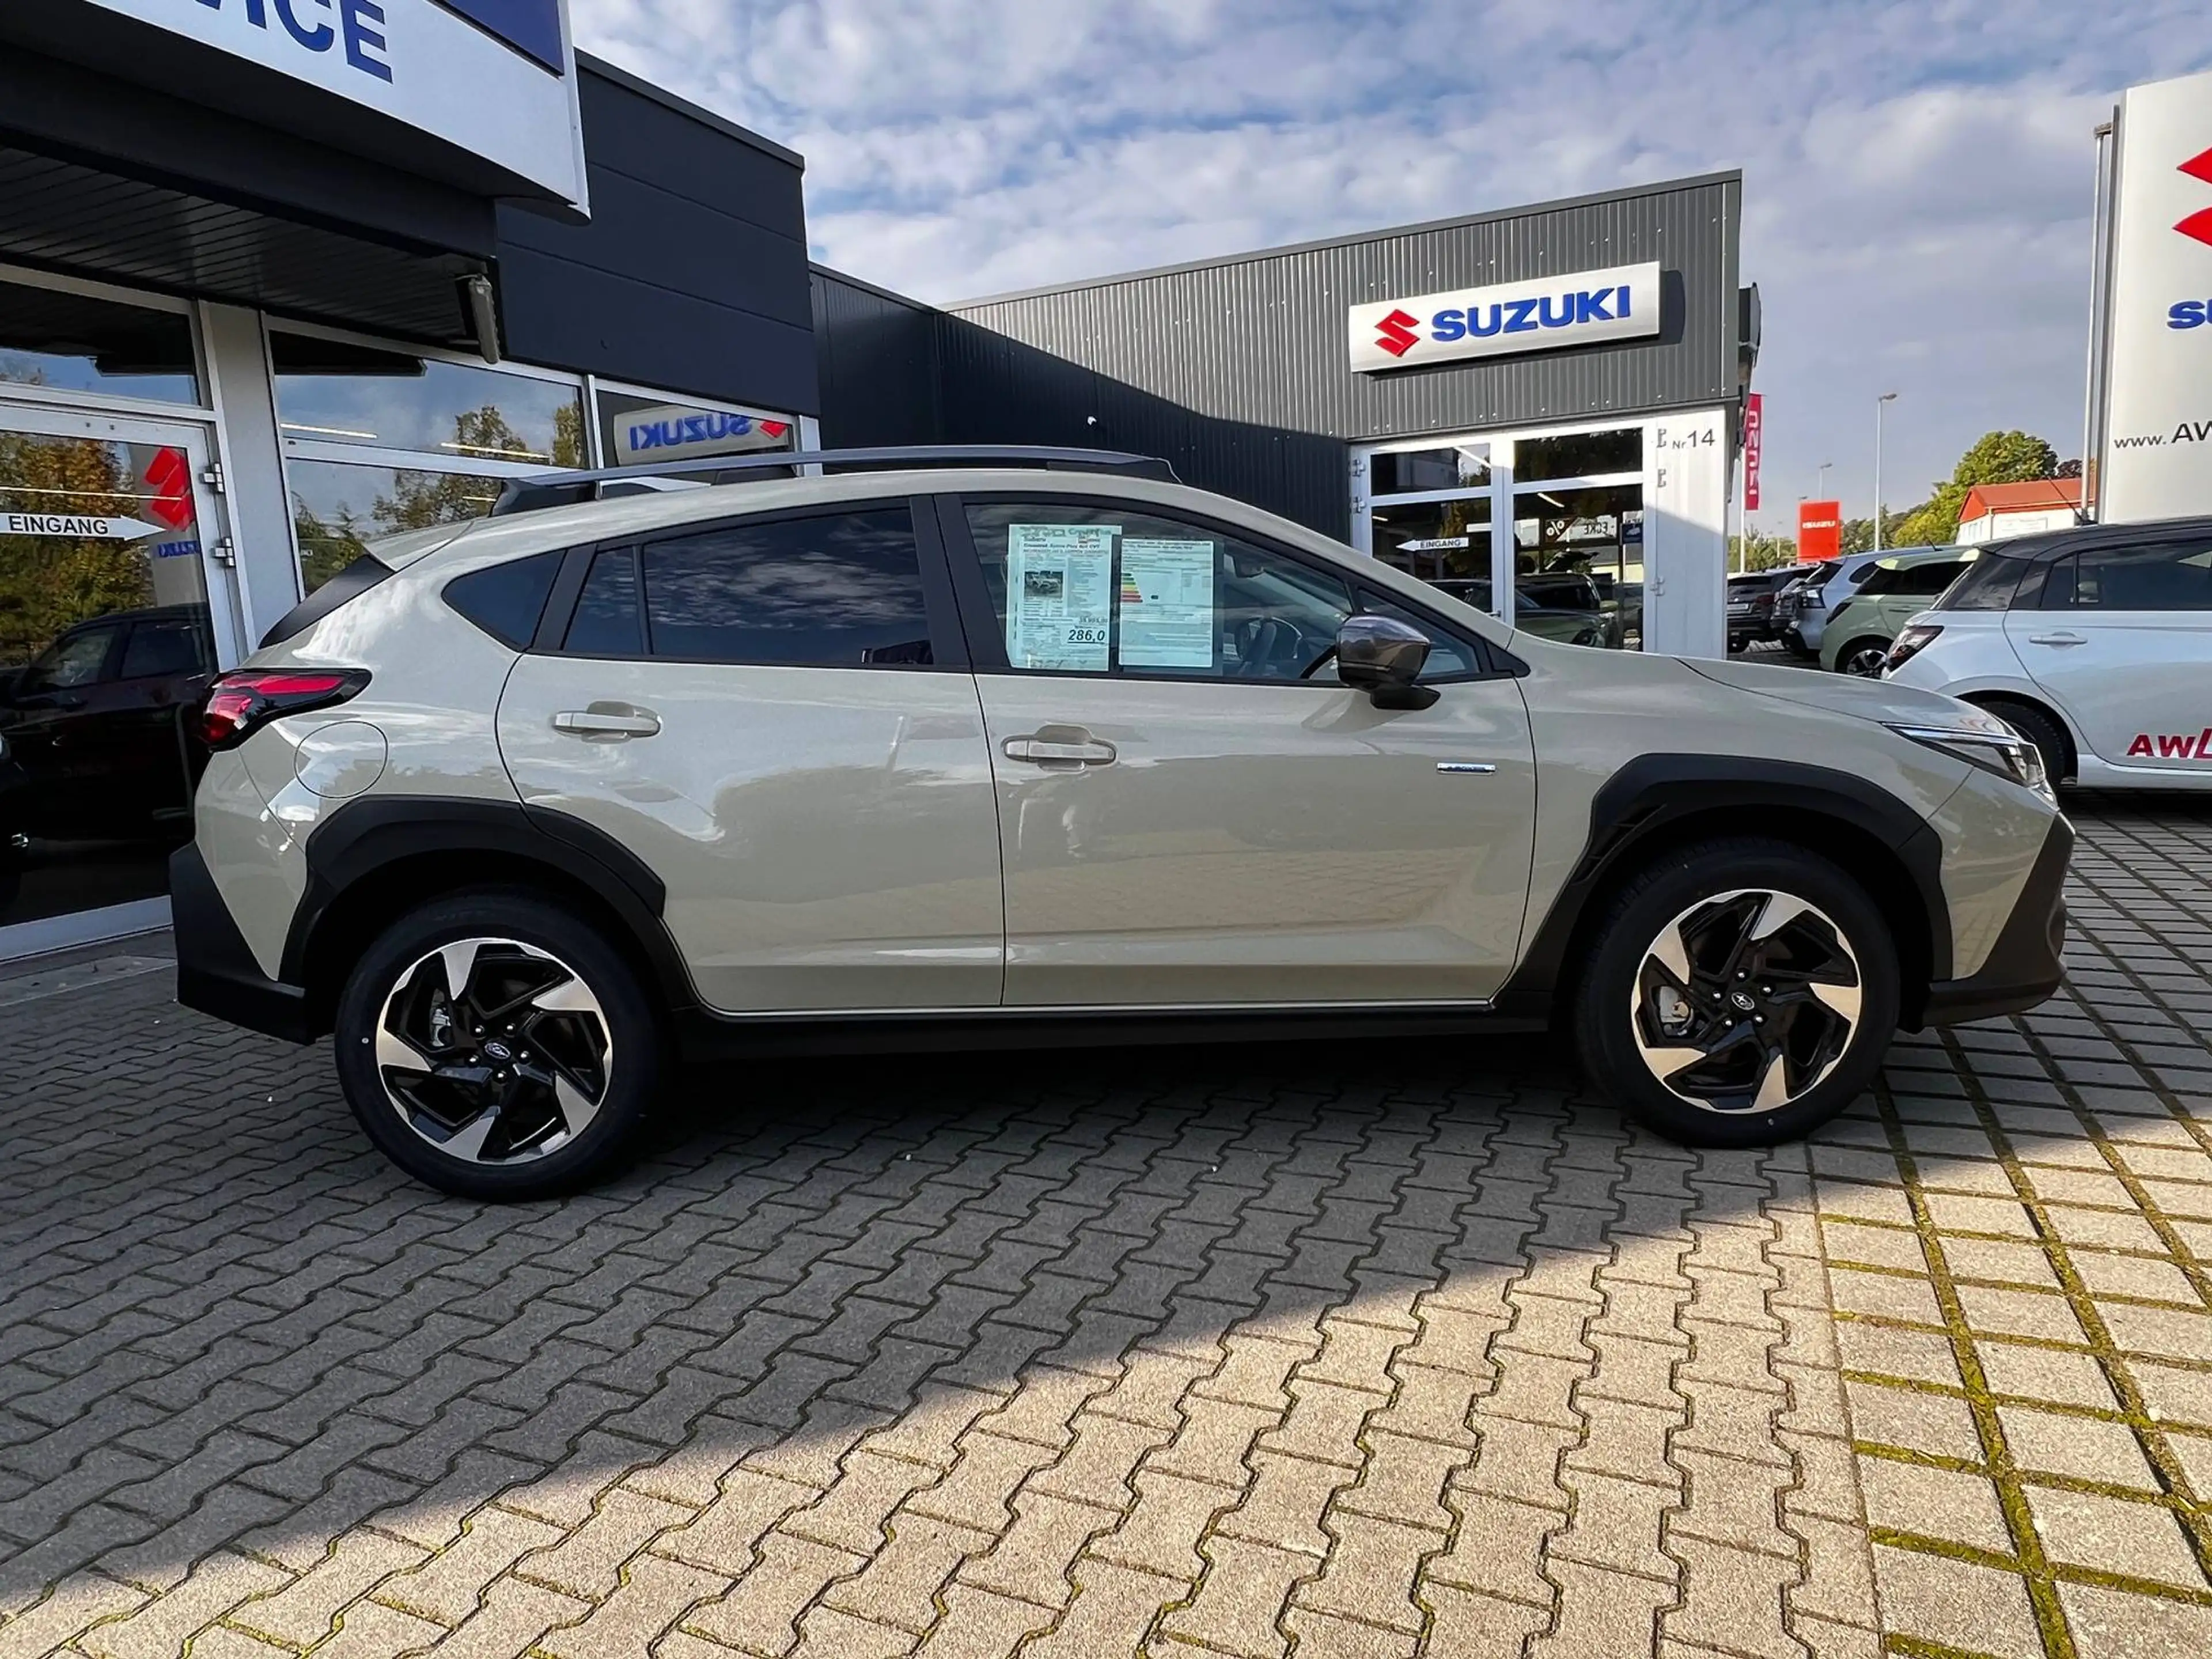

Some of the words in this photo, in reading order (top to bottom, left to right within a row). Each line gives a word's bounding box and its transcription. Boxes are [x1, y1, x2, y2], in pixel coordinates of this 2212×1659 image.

[196, 0, 393, 84] CE
[1431, 285, 1631, 342] SUZUKI
[2167, 298, 2212, 329] S
[1672, 440, 1687, 449] Nr
[1687, 429, 1715, 448] 14
[8, 516, 108, 534] EINGANG
[1420, 539, 1461, 548] EINGANG
[1069, 630, 1105, 642] 286,0
